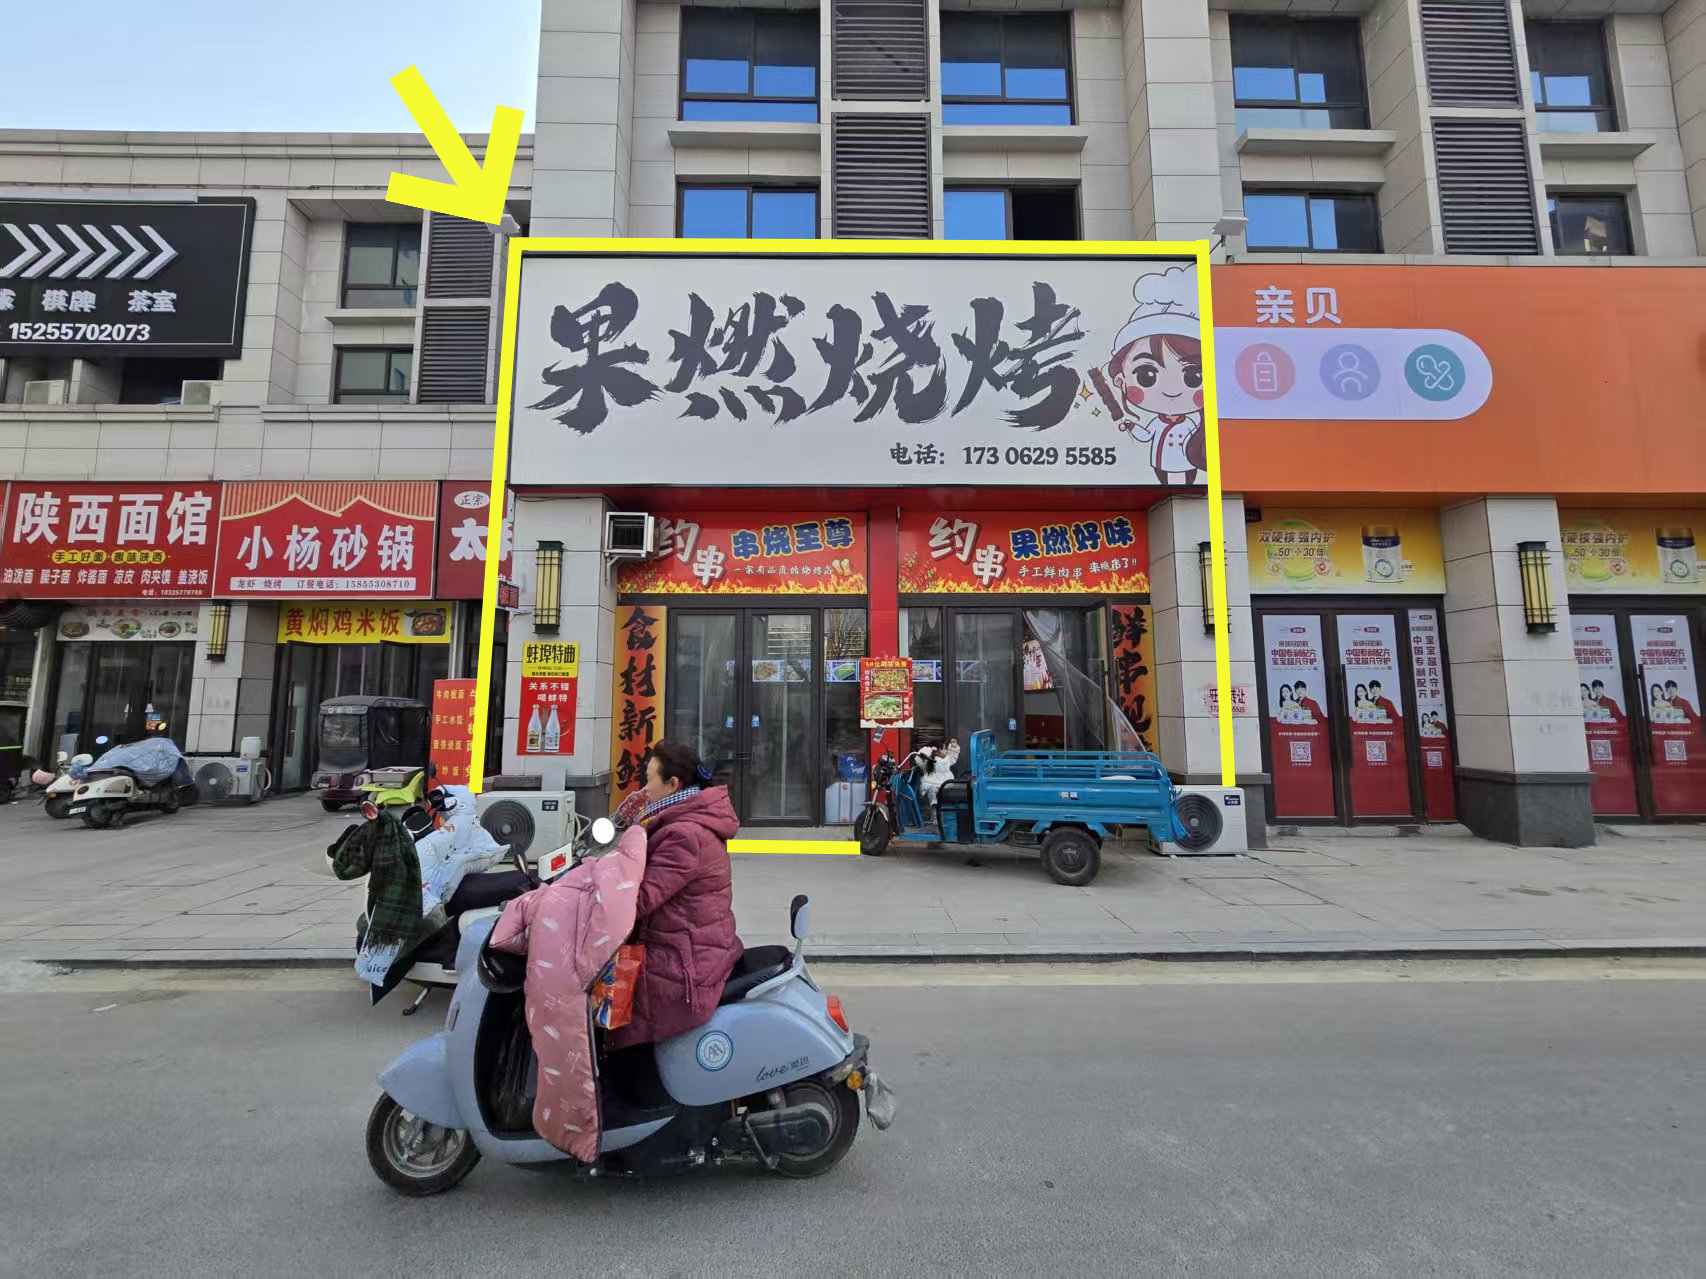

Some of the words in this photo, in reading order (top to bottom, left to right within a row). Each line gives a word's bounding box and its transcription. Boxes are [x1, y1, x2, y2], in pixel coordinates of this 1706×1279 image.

[42, 289, 97, 312] 棋牌
[127, 289, 177, 313] 茶室
[1254, 285, 1341, 325] 亲贝
[9, 322, 151, 341] 15255702073
[525, 279, 1088, 436] 果燃烧烤
[890, 442, 945, 465] 电话:
[962, 446, 999, 465] 173
[1005, 446, 1058, 465] 0629
[1065, 446, 1117, 465] 5585
[460, 494, 485, 505] 正宗
[13, 490, 212, 545] 陕西面馆
[236, 524, 415, 571] 小杨砂锅
[730, 518, 856, 561] 串烧至尊
[54, 551, 105, 563] 手工好面
[76, 569, 108, 584] 炸酱面
[113, 569, 135, 584] 凉皮
[140, 569, 171, 584] 肉夹馍
[284, 607, 401, 637] 黄焖鸡米饭
[526, 644, 575, 664] 蚌埠特曲
